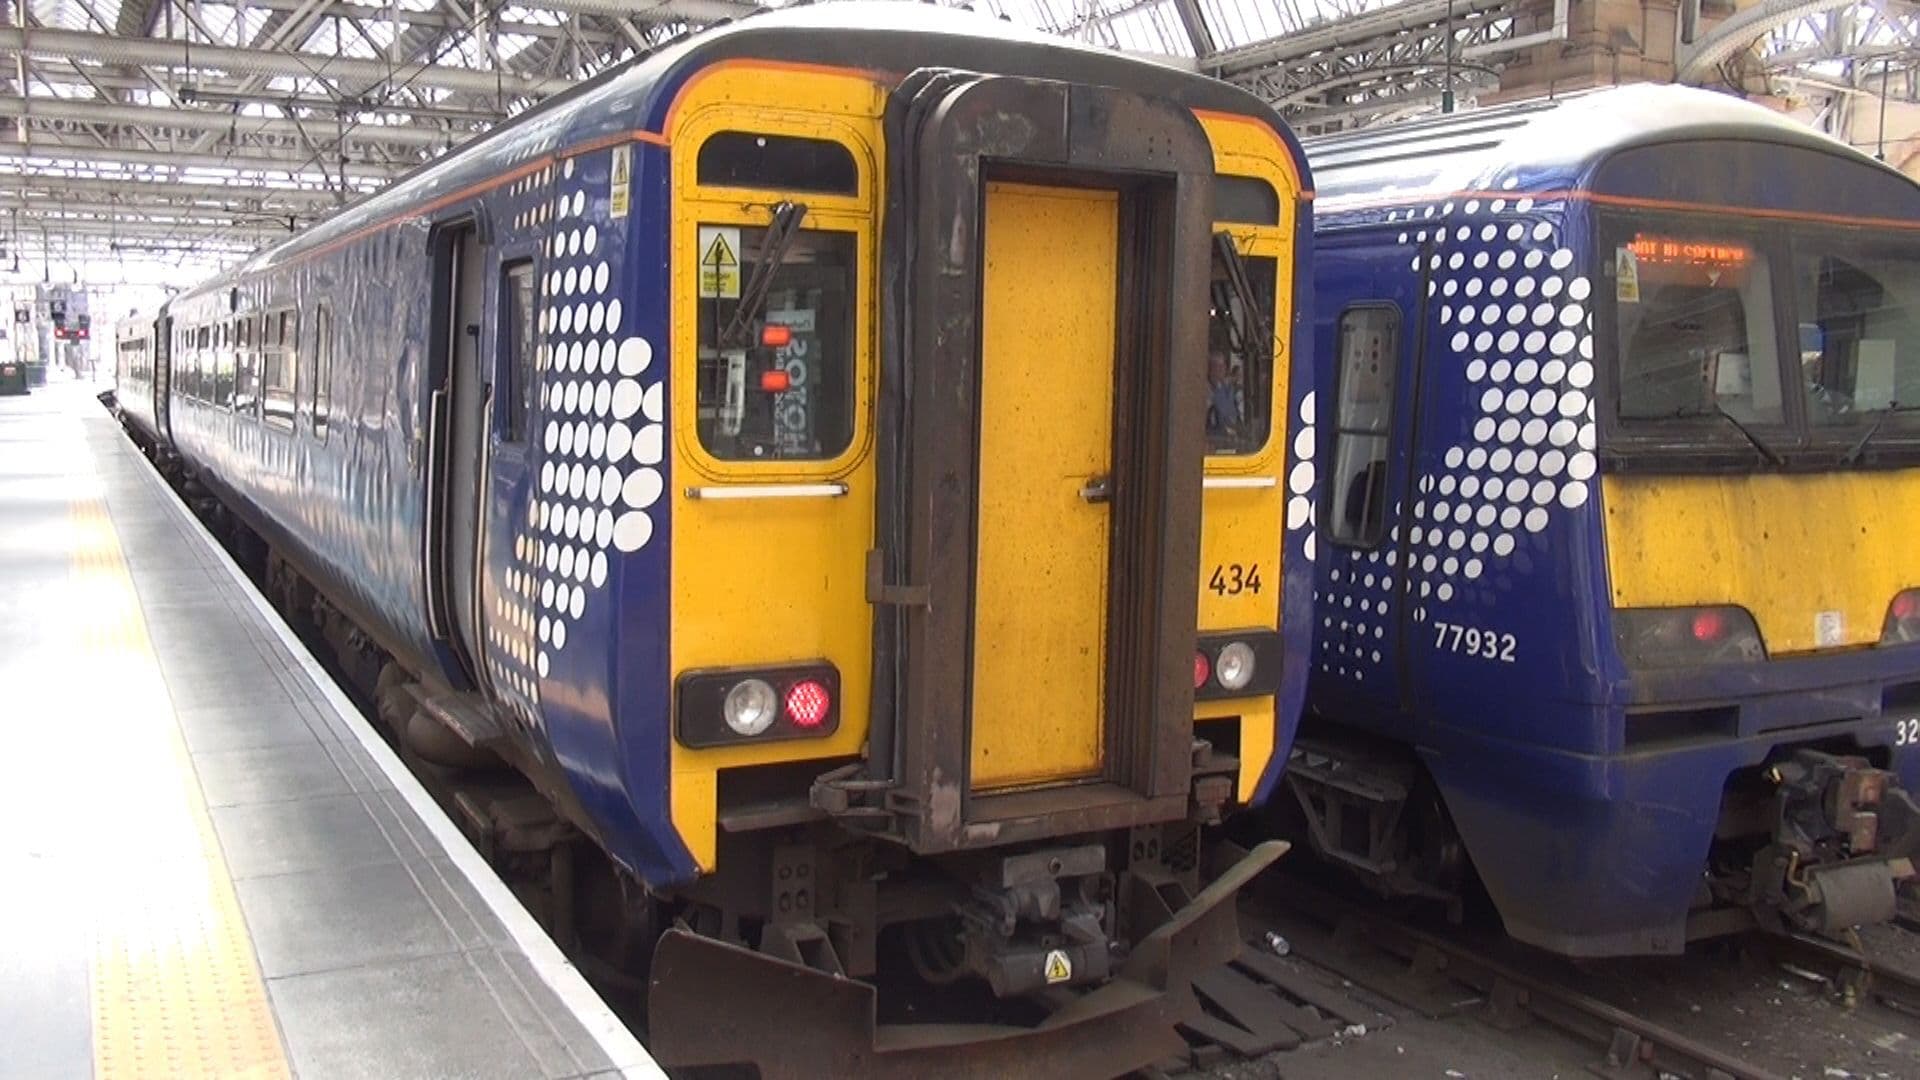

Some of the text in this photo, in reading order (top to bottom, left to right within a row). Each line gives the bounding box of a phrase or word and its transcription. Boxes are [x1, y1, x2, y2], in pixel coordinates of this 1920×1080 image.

[1209, 563, 1261, 596] 434
[1434, 622, 1516, 662] 77932
[1896, 718, 1920, 746] 32
